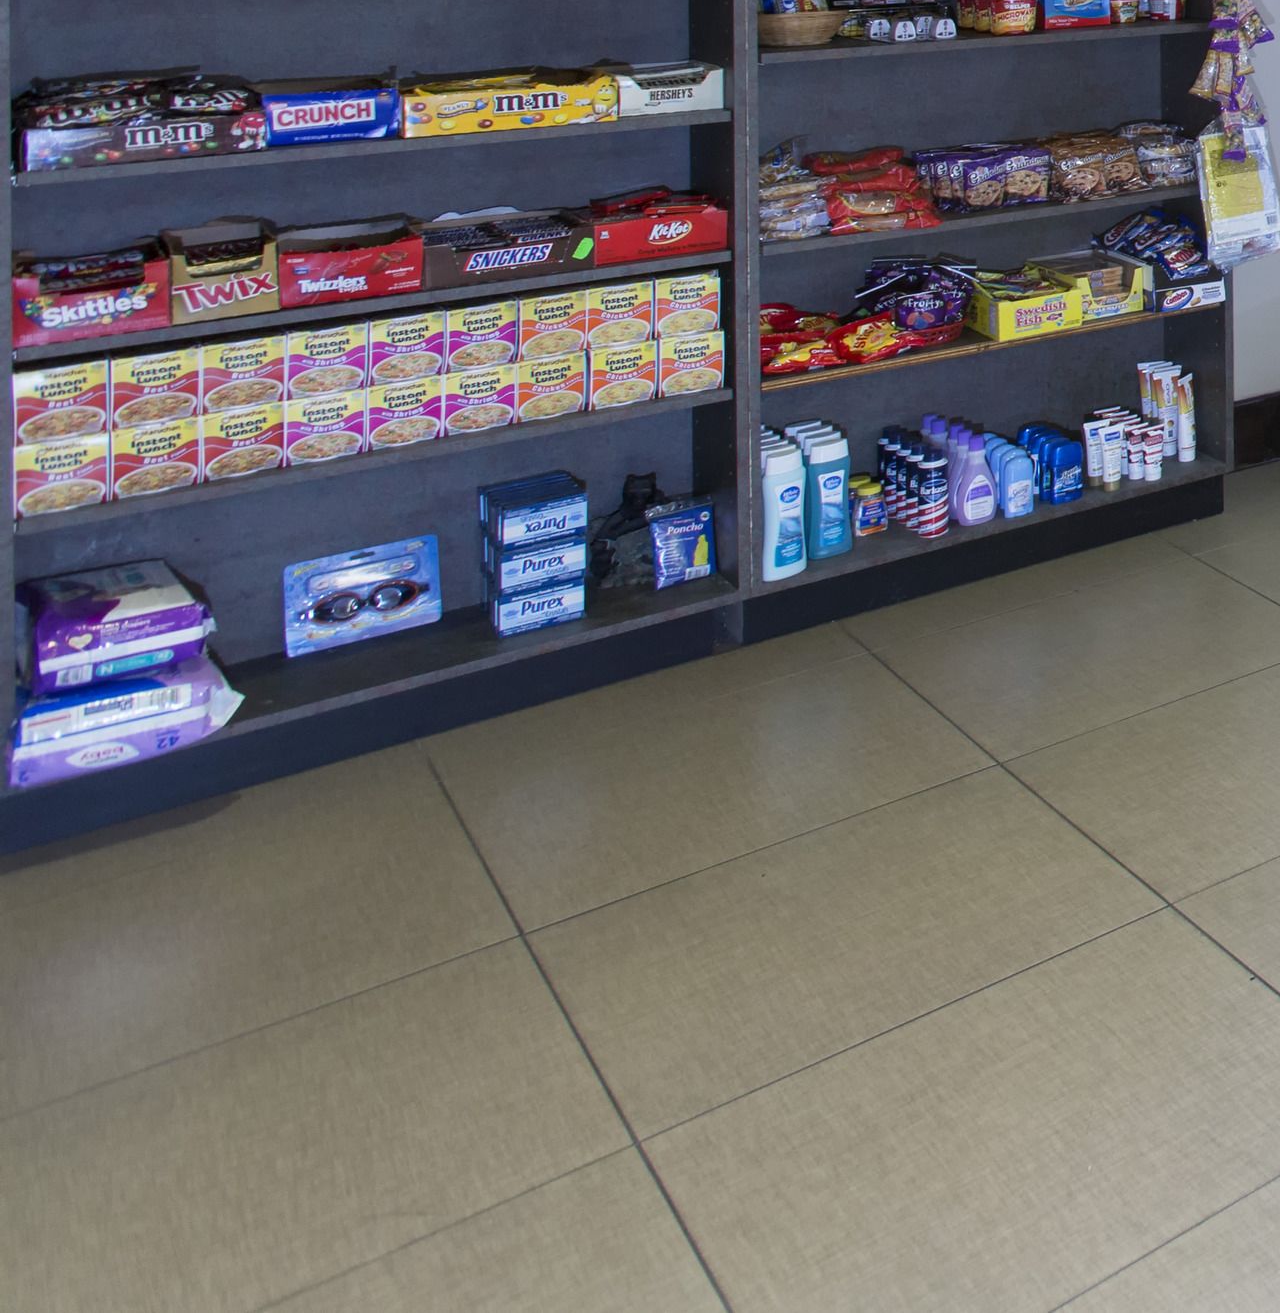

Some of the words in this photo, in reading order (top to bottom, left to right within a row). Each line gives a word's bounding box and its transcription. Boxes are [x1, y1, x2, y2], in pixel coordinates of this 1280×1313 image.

[650, 88, 694, 101] HERSHEY'S
[277, 102, 371, 126] CRUNCH
[471, 245, 550, 271] SNICKERS
[298, 275, 367, 293] Twizzlers
[670, 285, 706, 295] Instant
[601, 294, 638, 305] Instant
[673, 292, 702, 301] Lunch
[42, 294, 148, 327] Skittles
[534, 303, 574, 314] Instant
[605, 301, 634, 311] Lunch
[670, 301, 701, 309] Chicken
[1016, 300, 1067, 317] Swedish
[463, 314, 502, 326] Instant
[538, 311, 570, 321] Lunch
[601, 310, 633, 319] Chicken
[468, 322, 499, 332] Lunch
[535, 320, 567, 330] Chicken
[1016, 316, 1042, 327] Fish
[387, 325, 429, 337] Instant
[472, 331, 500, 341] Shrimp
[392, 333, 425, 343] Lunch
[305, 338, 350, 350] Instant
[396, 342, 426, 353] Shrimp
[674, 344, 710, 355] Instant
[220, 350, 268, 363] Instant
[309, 346, 345, 357] Lunch
[678, 351, 707, 360] Lunch
[225, 359, 262, 370] Lunch
[315, 356, 347, 366] Shrimp
[605, 355, 643, 366] Instant
[674, 360, 706, 369] Chicken
[131, 364, 181, 377] Instant
[530, 365, 571, 377] Instant
[609, 362, 639, 372] Lunch
[136, 373, 176, 384] Lunch
[535, 373, 567, 384] Lunch
[605, 371, 637, 381] Chicken
[34, 377, 88, 391] Instant
[459, 378, 501, 390] Instant
[532, 382, 565, 393] Chicken
[40, 386, 82, 398] Lunch
[384, 390, 426, 402] Instant
[464, 386, 497, 396] Lunch
[388, 398, 423, 408] Lunch
[468, 394, 498, 405] Shrimp
[302, 404, 348, 417] Instant
[393, 406, 424, 418] Shrimp
[308, 412, 343, 423] Lunch
[220, 417, 268, 432] Instant
[313, 422, 345, 432] Shrimp
[225, 425, 262, 438] Lunch
[131, 433, 181, 448] Instant
[136, 443, 176, 455] Lunch
[34, 450, 88, 464] Instant
[40, 459, 82, 471] Lunch
[524, 514, 566, 534] Purex
[667, 523, 703, 536] Poncho
[522, 553, 565, 573] Purex
[521, 595, 563, 615] Purex
